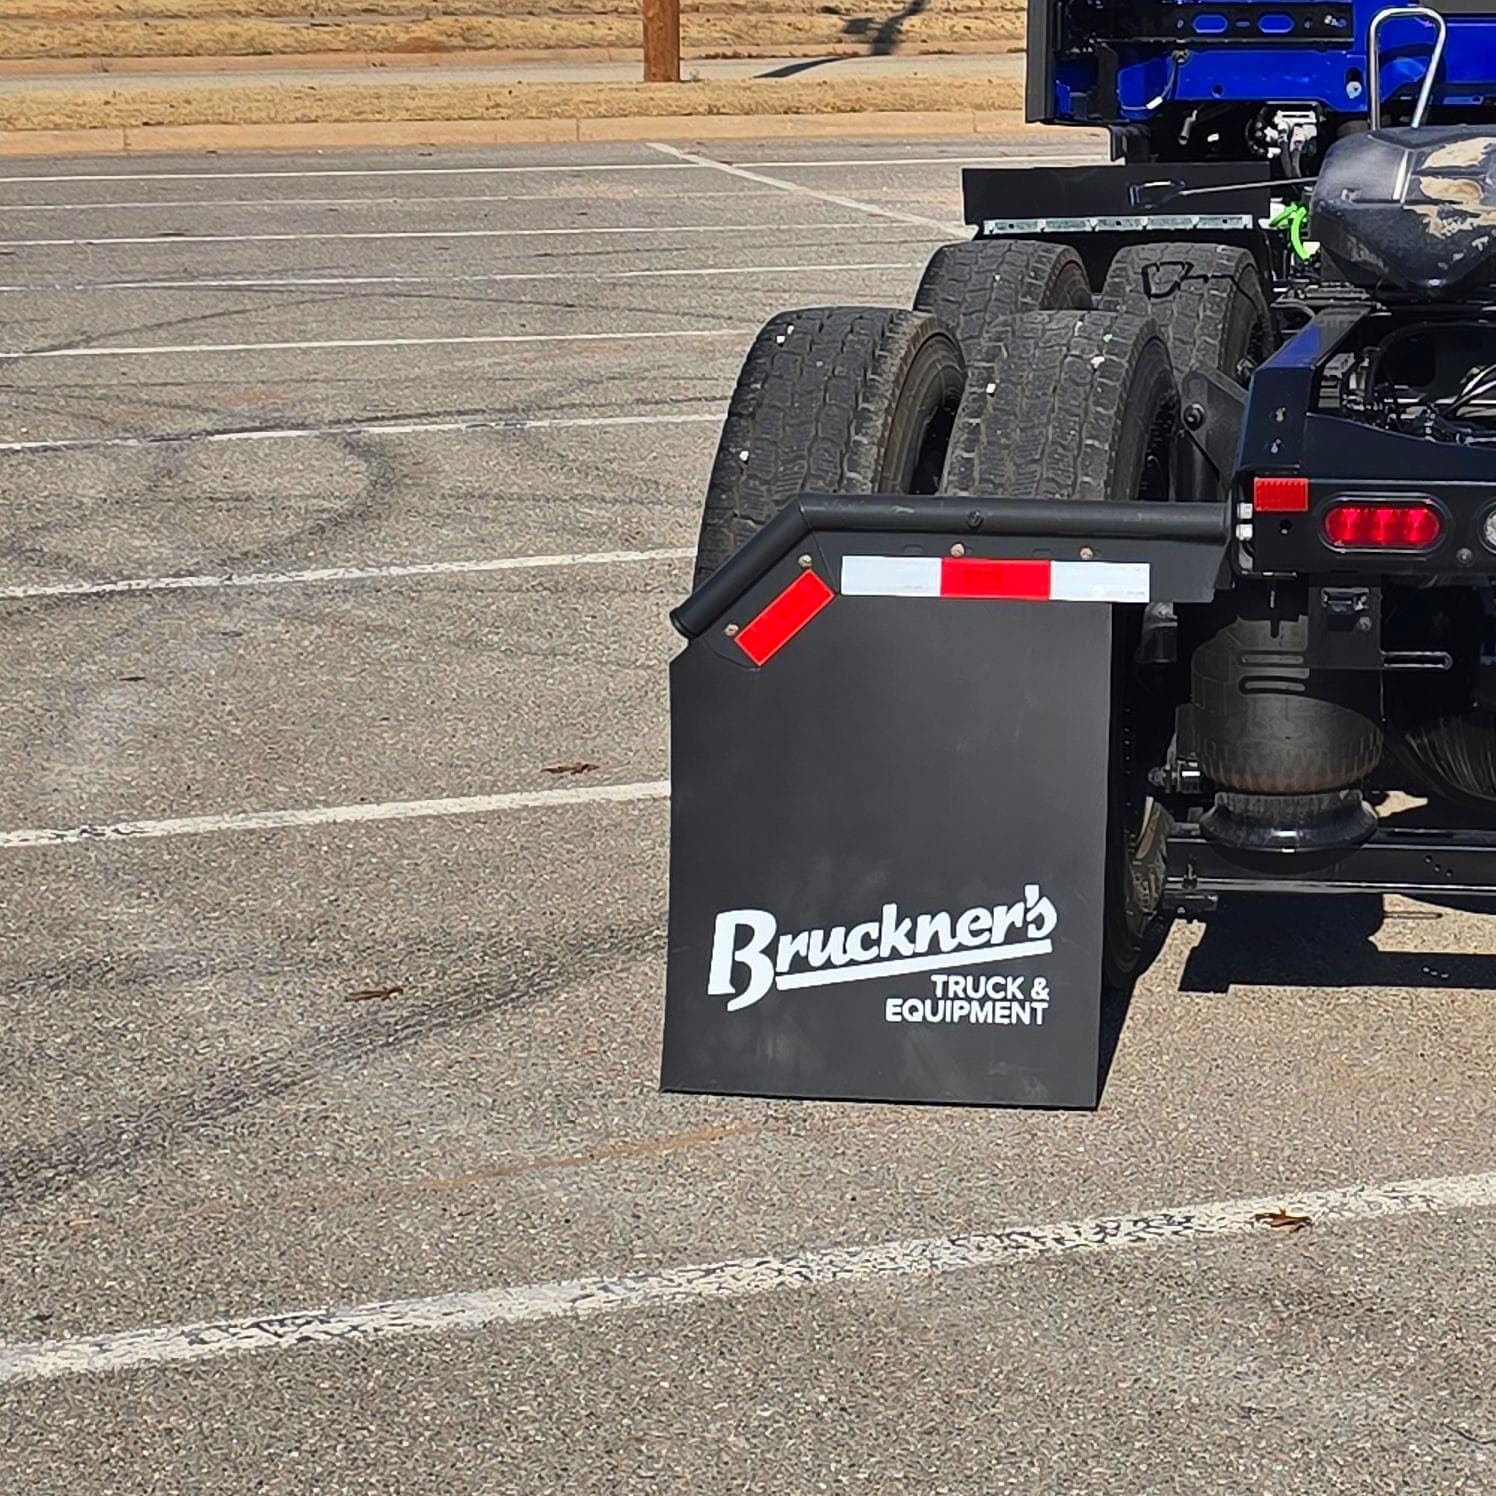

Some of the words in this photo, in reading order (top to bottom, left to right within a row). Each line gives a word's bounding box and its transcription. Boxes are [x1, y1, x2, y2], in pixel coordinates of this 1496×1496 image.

[707, 884, 1058, 1012] Bruckner's
[930, 974, 1025, 1000] TRUCK
[1030, 977, 1050, 1001] &
[885, 998, 1049, 1025] EQUIPMENT
